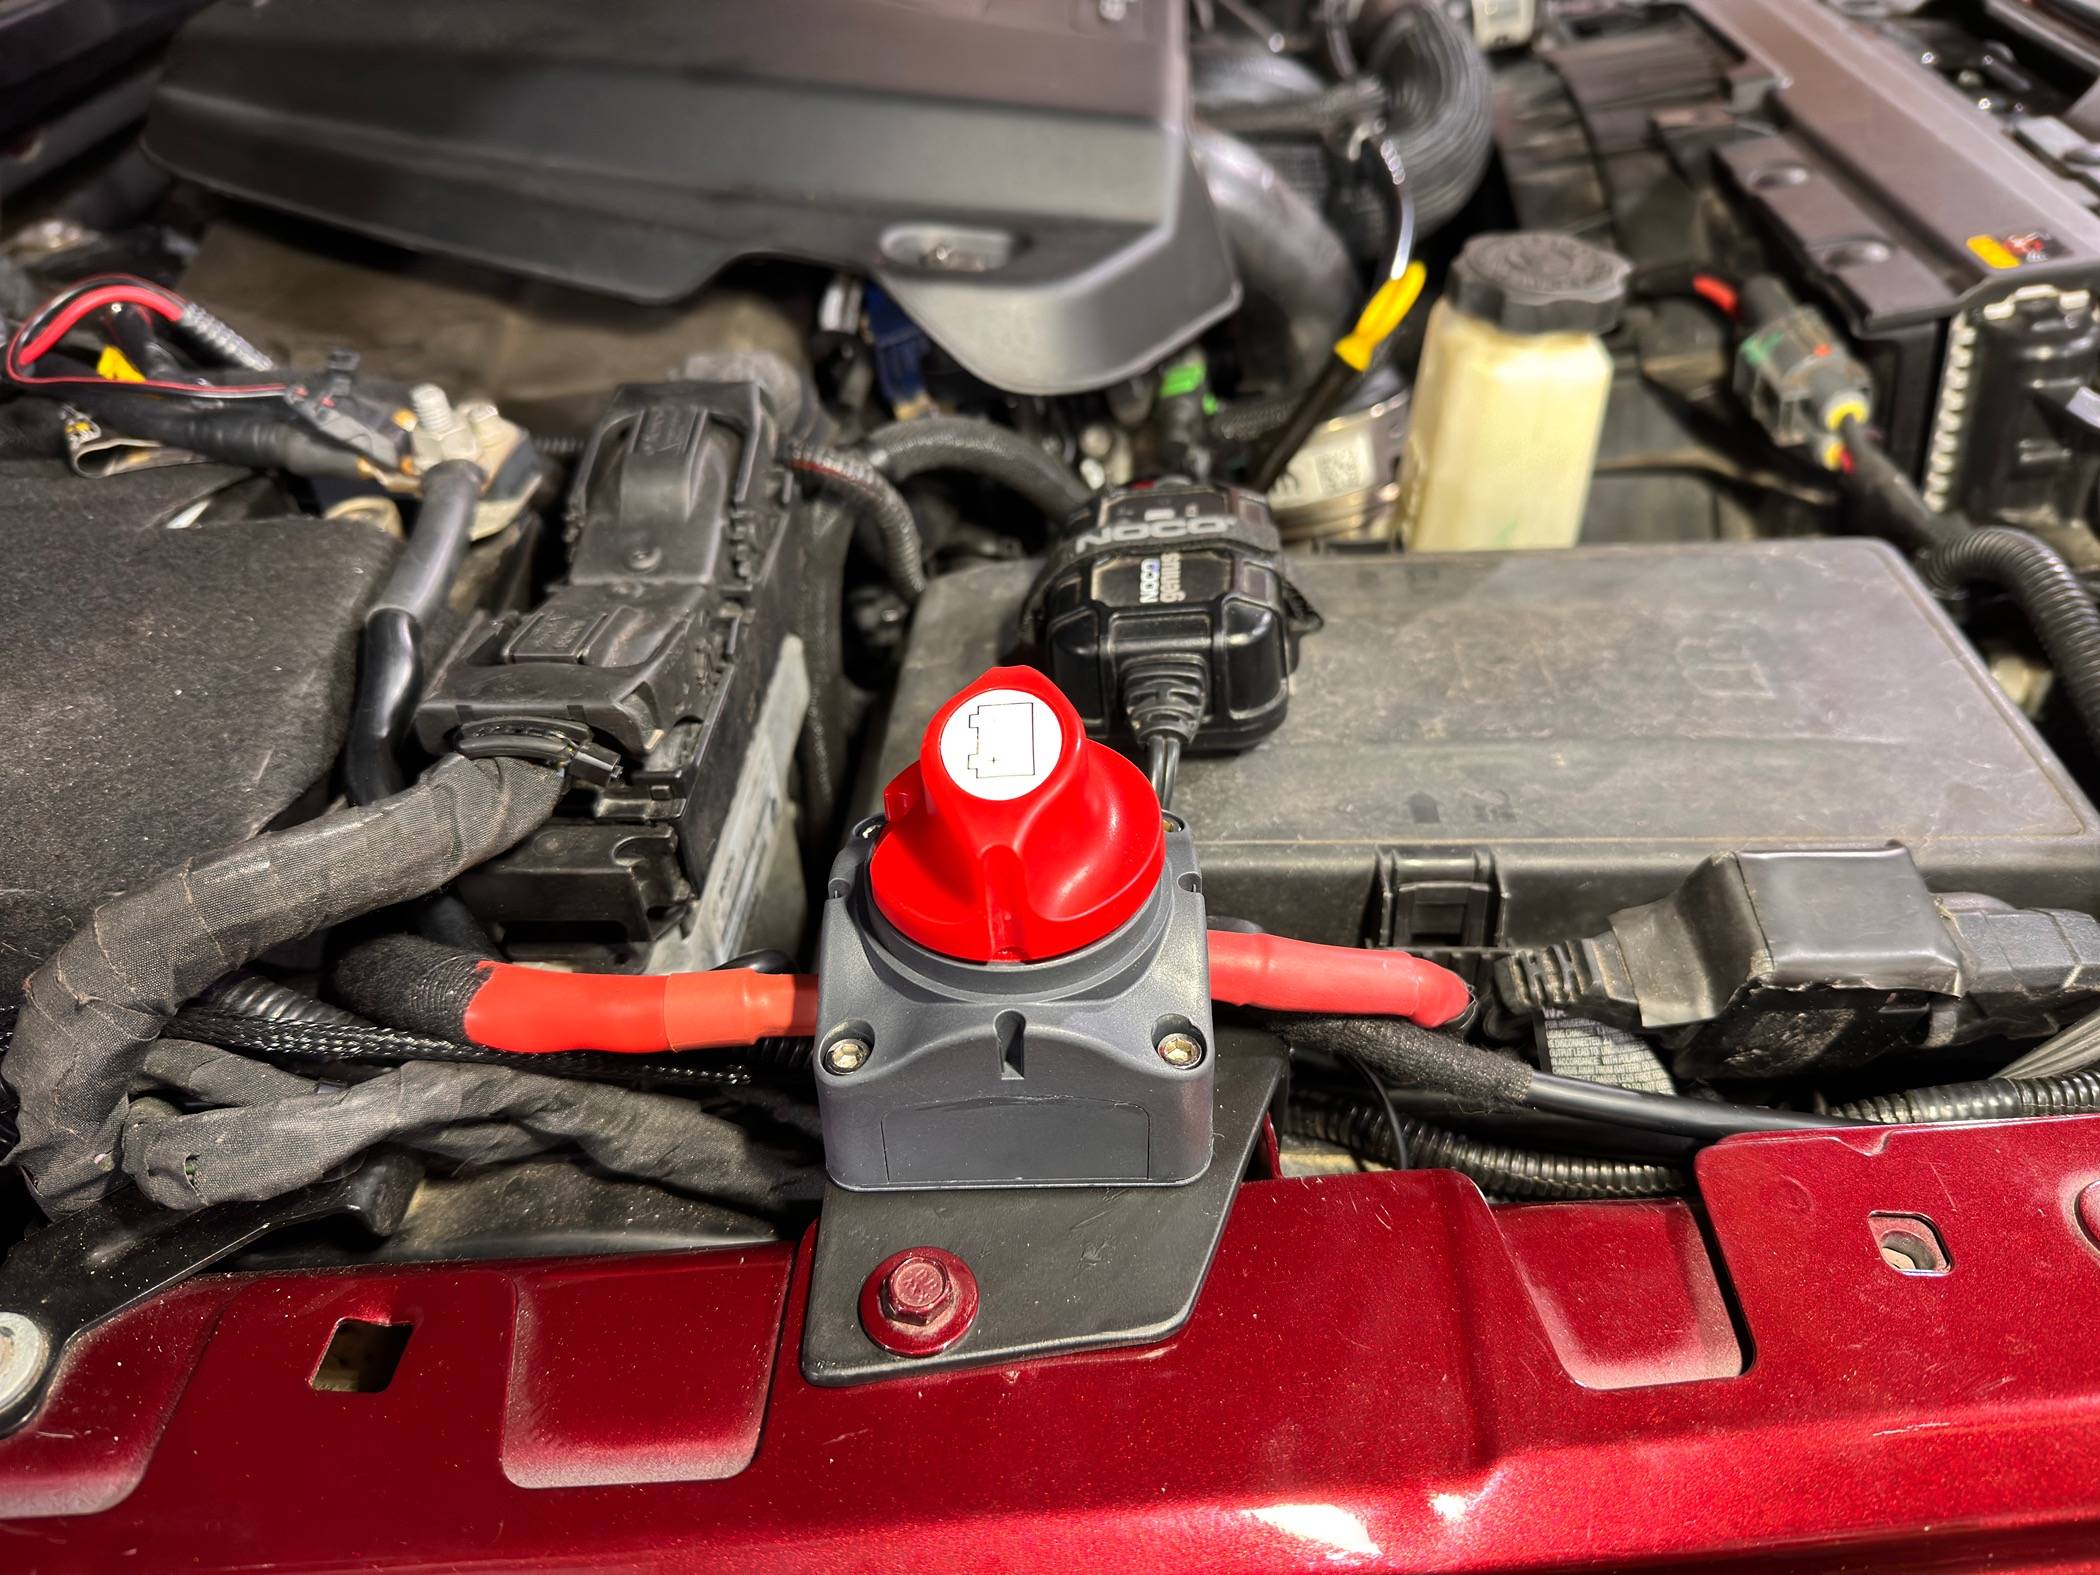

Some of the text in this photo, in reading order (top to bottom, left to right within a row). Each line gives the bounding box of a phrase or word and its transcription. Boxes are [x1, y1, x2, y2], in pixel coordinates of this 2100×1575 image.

[1076, 514, 1228, 553] NOCO
[1139, 558, 1161, 603] NOCO
[1160, 552, 1186, 603] genius
[1545, 1020, 1558, 1029] FOR
[1549, 1047, 1573, 1057] OUTPUT
[1573, 1047, 1590, 1056] LEAD
[1590, 1047, 1599, 1056] TO
[1602, 1055, 1617, 1065] WITH
[1595, 1064, 1613, 1075] FROM
